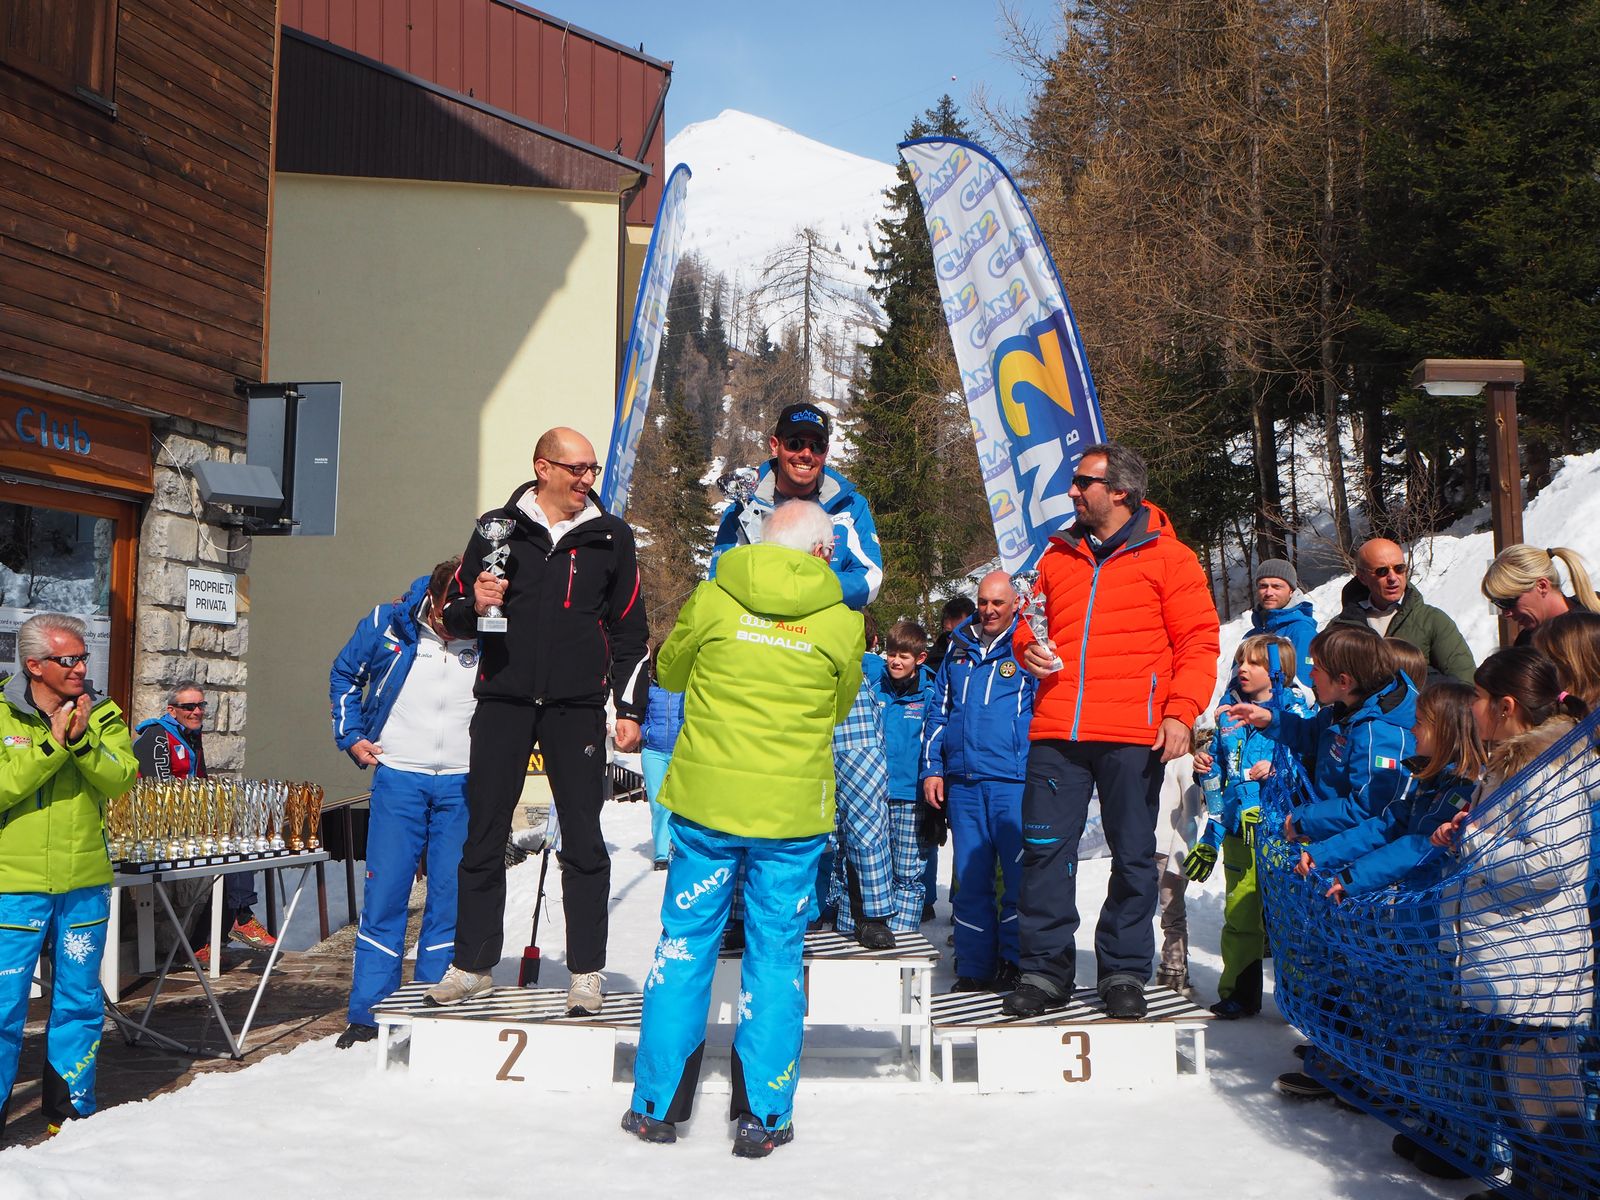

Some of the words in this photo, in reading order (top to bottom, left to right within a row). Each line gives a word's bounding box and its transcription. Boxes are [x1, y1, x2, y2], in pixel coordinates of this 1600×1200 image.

[937, 209, 1001, 280] CLAN2
[969, 278, 1031, 349] CLAN2
[16, 406, 91, 455] Club
[195, 597, 227, 611] PRIVATA
[776, 620, 807, 635] Audi
[736, 630, 812, 653] BONALDI
[675, 867, 732, 910] CLAN2
[495, 1028, 528, 1081] 2
[1061, 1031, 1092, 1083] 3
